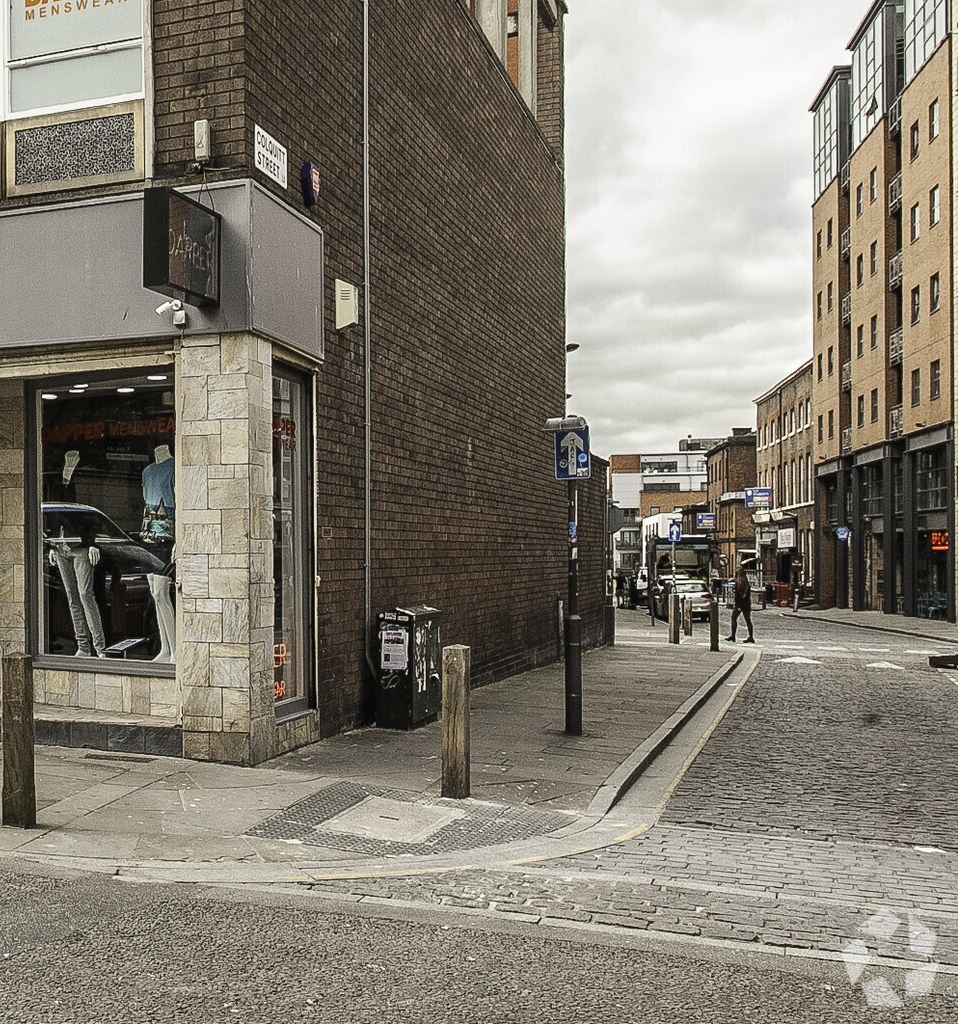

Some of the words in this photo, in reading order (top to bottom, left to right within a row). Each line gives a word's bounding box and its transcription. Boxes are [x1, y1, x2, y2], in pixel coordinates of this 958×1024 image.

[257, 130, 286, 165] COLQUITT
[257, 151, 280, 179] STREET
[107, 415, 175, 437] MENSWEA
